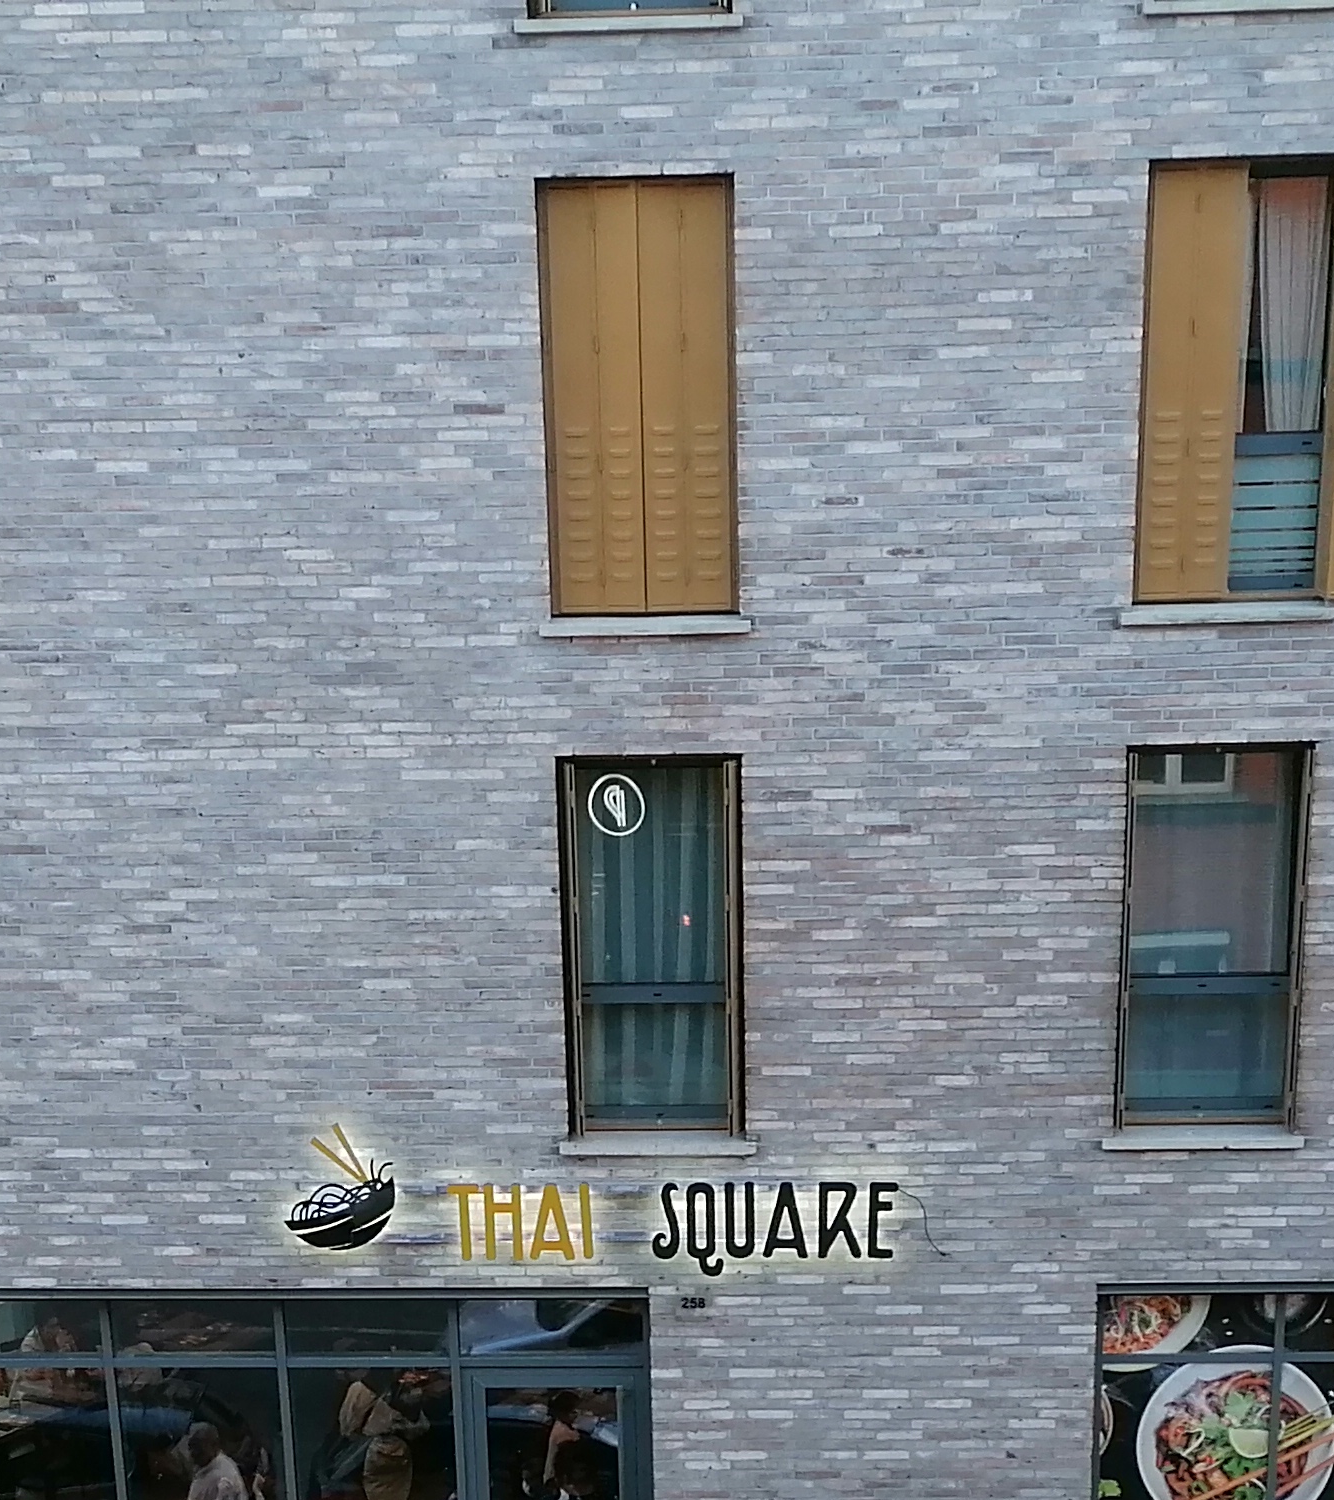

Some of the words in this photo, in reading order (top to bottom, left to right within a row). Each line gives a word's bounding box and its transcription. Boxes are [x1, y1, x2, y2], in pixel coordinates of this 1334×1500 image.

[447, 1183, 593, 1260] THAI
[652, 1181, 899, 1276] SQUARE
[681, 1297, 706, 1309] 258
